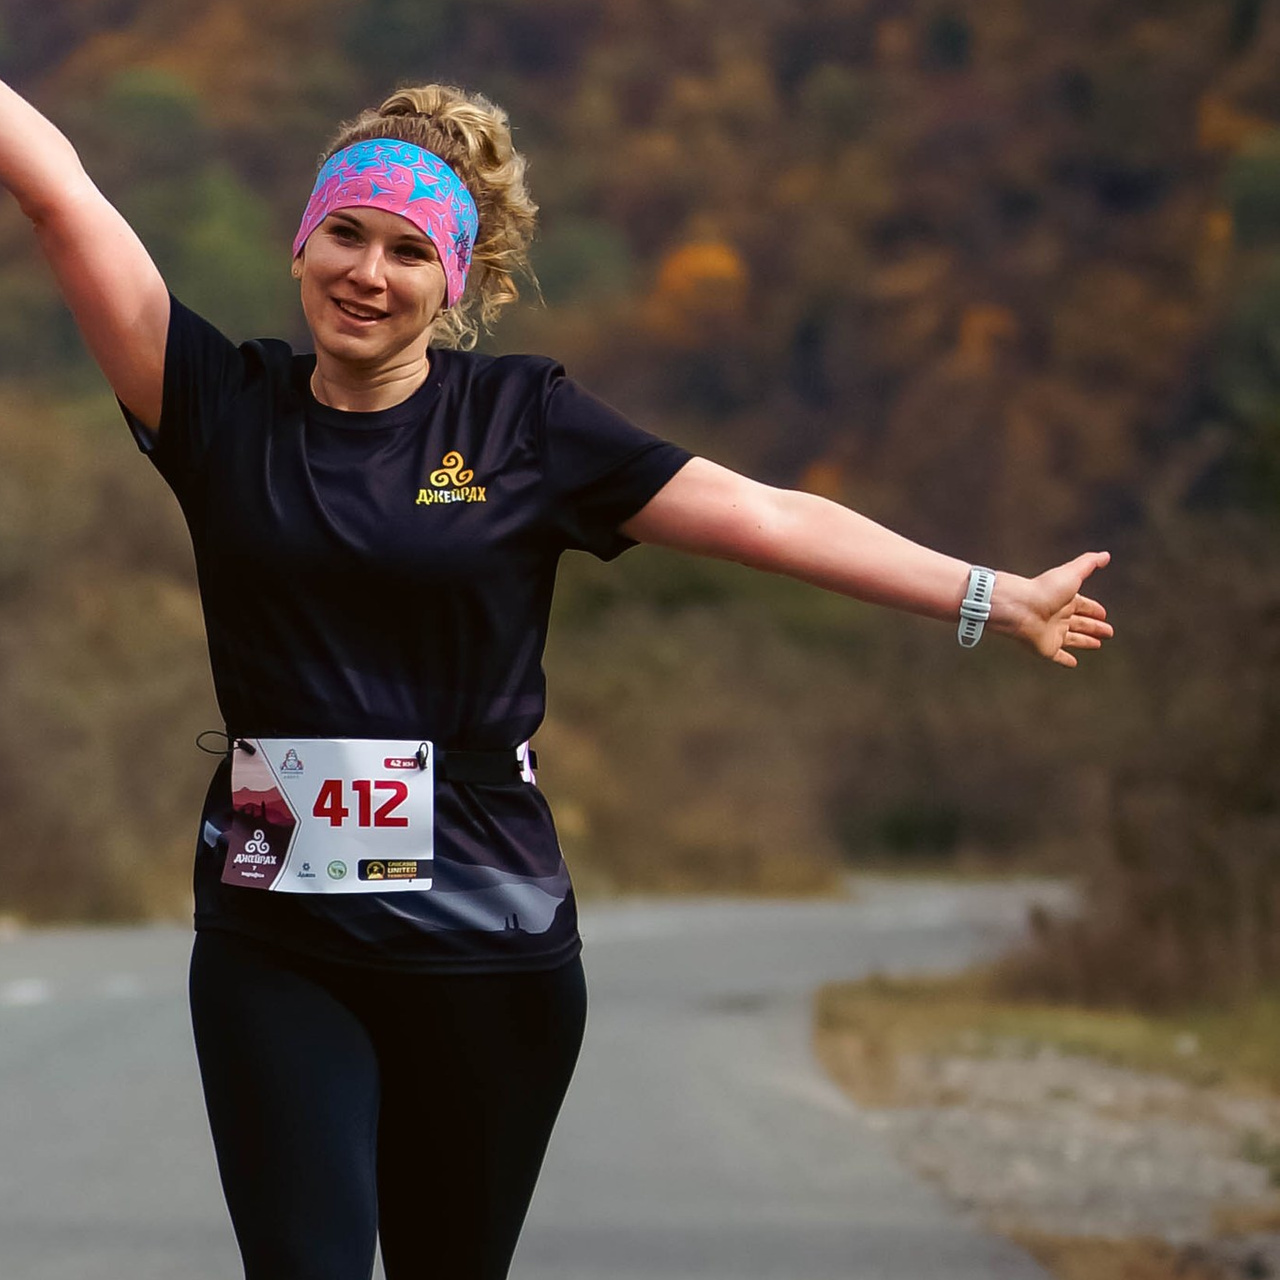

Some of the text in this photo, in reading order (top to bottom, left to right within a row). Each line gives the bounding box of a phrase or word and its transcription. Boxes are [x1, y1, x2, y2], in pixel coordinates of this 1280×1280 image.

[415, 486, 487, 505] ДЖЕЙРАХ
[390, 759, 402, 768] 42
[312, 779, 409, 827] 412
